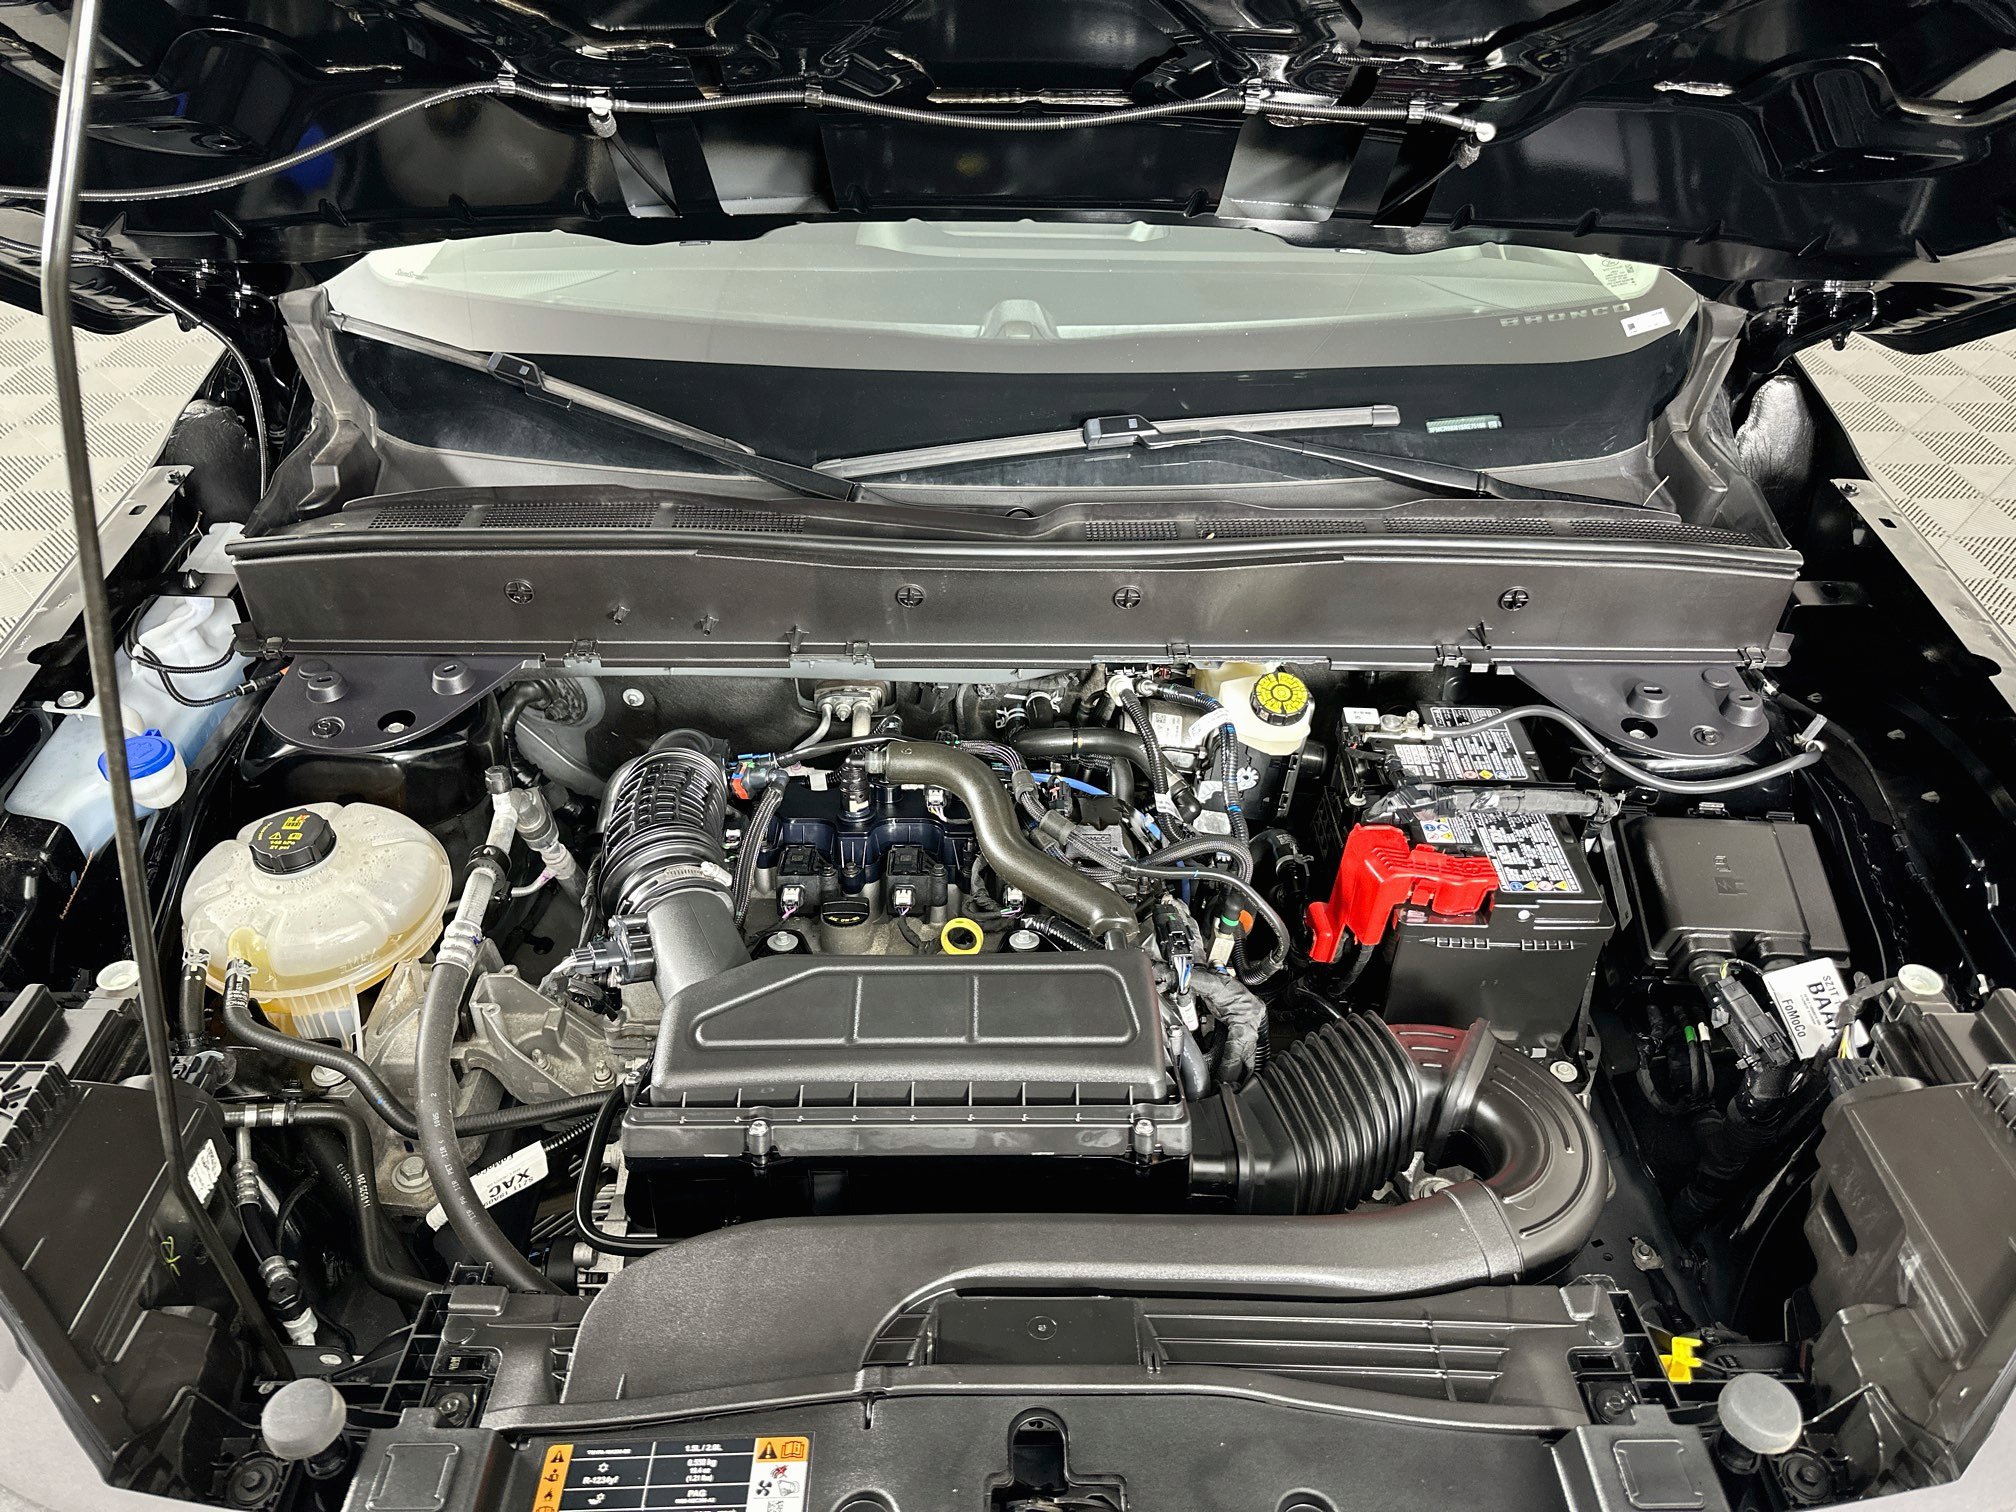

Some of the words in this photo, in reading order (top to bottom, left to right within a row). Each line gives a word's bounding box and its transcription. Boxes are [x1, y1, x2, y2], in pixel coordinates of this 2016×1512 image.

[1500, 302, 1631, 327] BRONCO
[1782, 999, 1807, 1038] FoMoCo
[489, 1168, 530, 1198] XAC
[582, 1475, 620, 1486] R-1234yf
[687, 1489, 708, 1498] PAG
